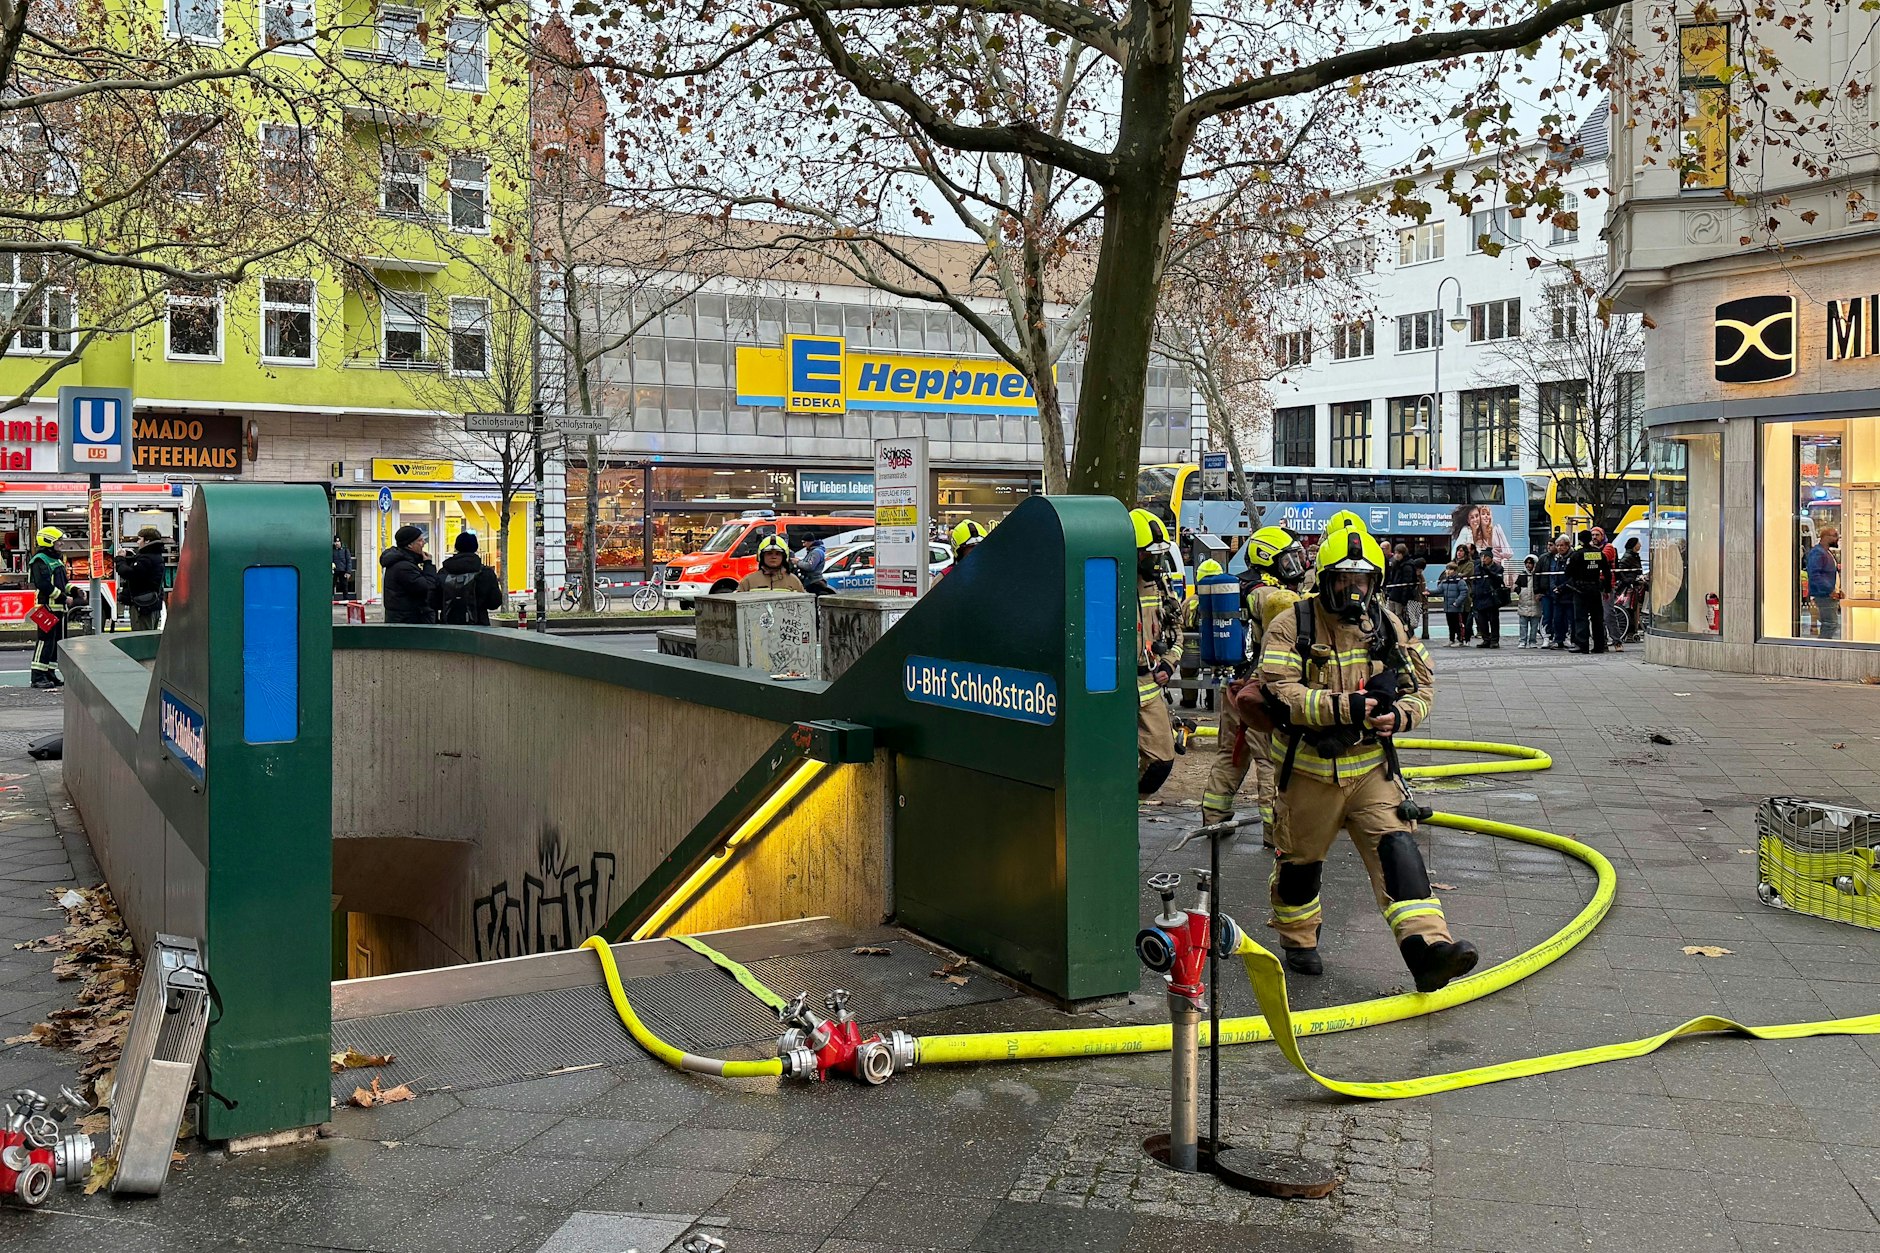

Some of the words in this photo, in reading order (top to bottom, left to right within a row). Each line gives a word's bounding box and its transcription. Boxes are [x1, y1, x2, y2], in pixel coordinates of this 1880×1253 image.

[792, 397, 841, 408] EDEKA
[80, 401, 116, 442] U
[471, 416, 525, 427] Schloßstraße
[555, 419, 602, 429] Schloßstraße
[90, 449, 106, 458] U9
[802, 480, 818, 493] Wir
[820, 480, 847, 494] lieben
[1283, 507, 1299, 519] JOY
[1301, 507, 1314, 518] OF
[906, 665, 948, 697] U-Bhf
[951, 671, 1057, 717] Schloßstraße
[1120, 1041, 1142, 1051] 2016
